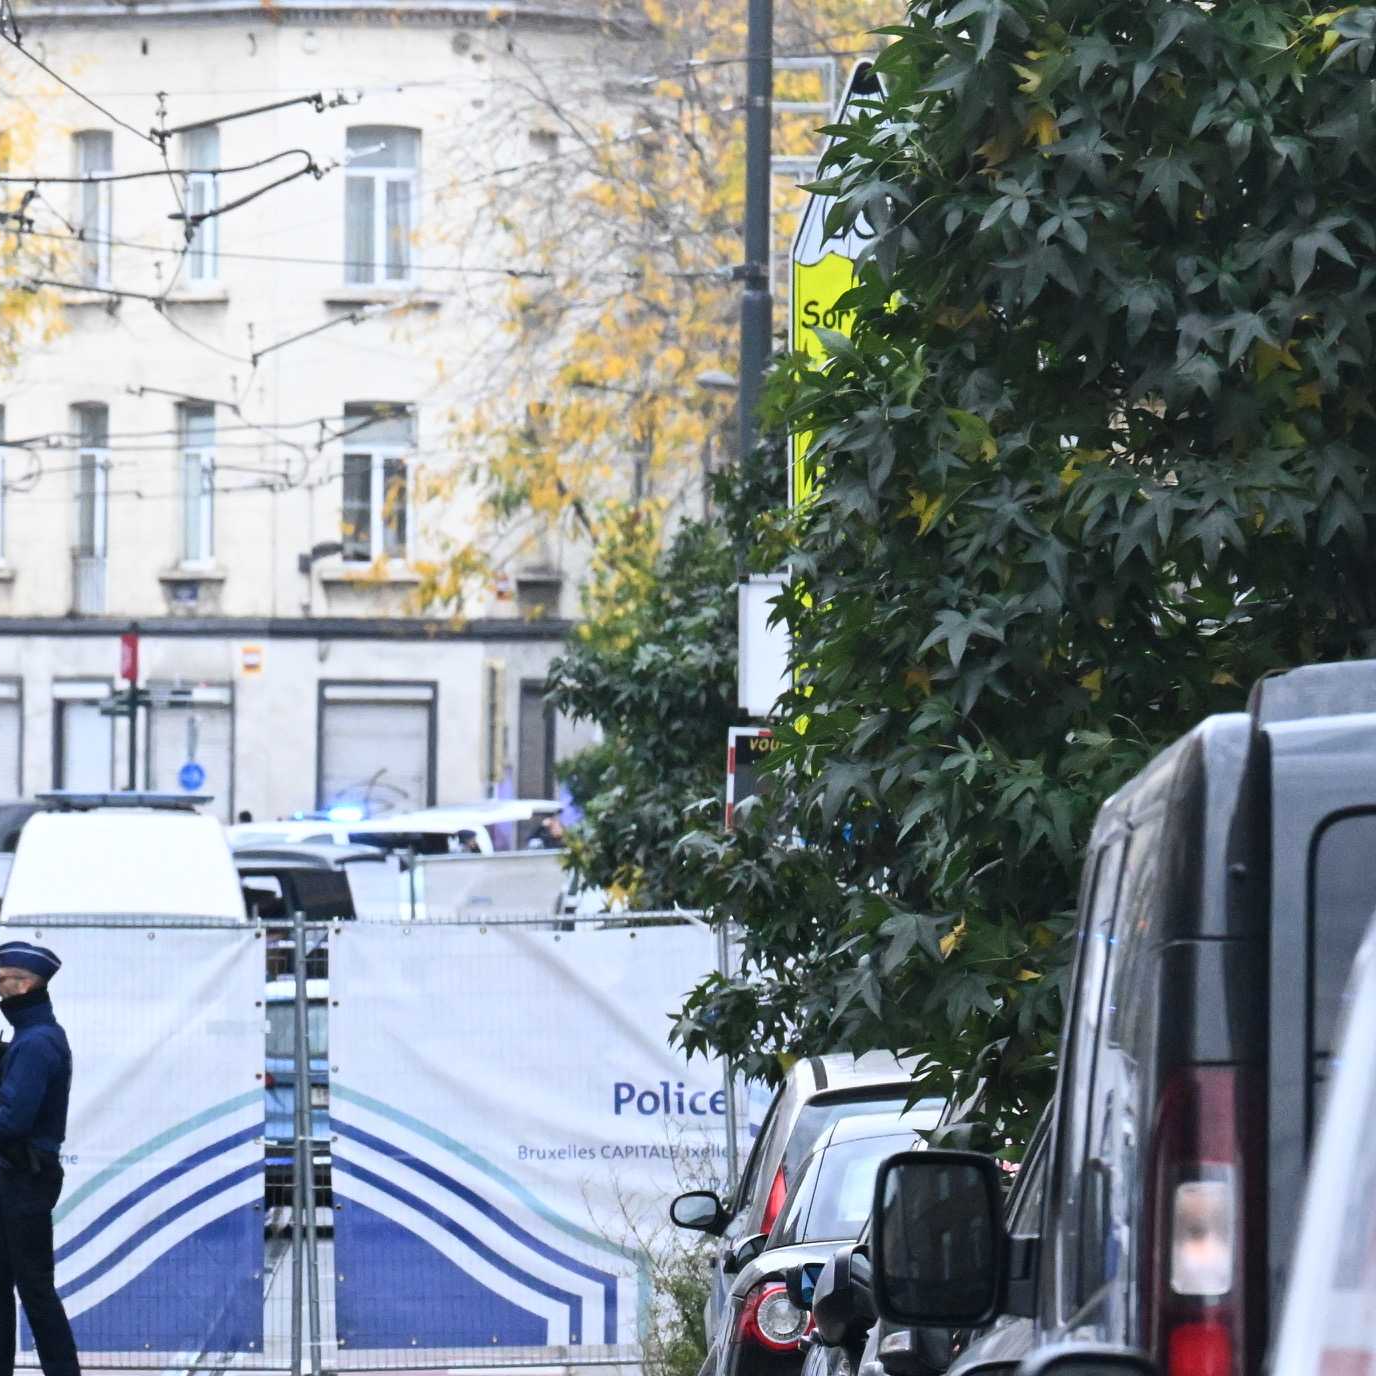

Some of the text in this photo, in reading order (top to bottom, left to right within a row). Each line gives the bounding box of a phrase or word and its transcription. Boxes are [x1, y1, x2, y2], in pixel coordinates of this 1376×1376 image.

[801, 300, 858, 330] Sor
[614, 1081, 728, 1116] Police
[518, 1144, 596, 1160] Bruxelles
